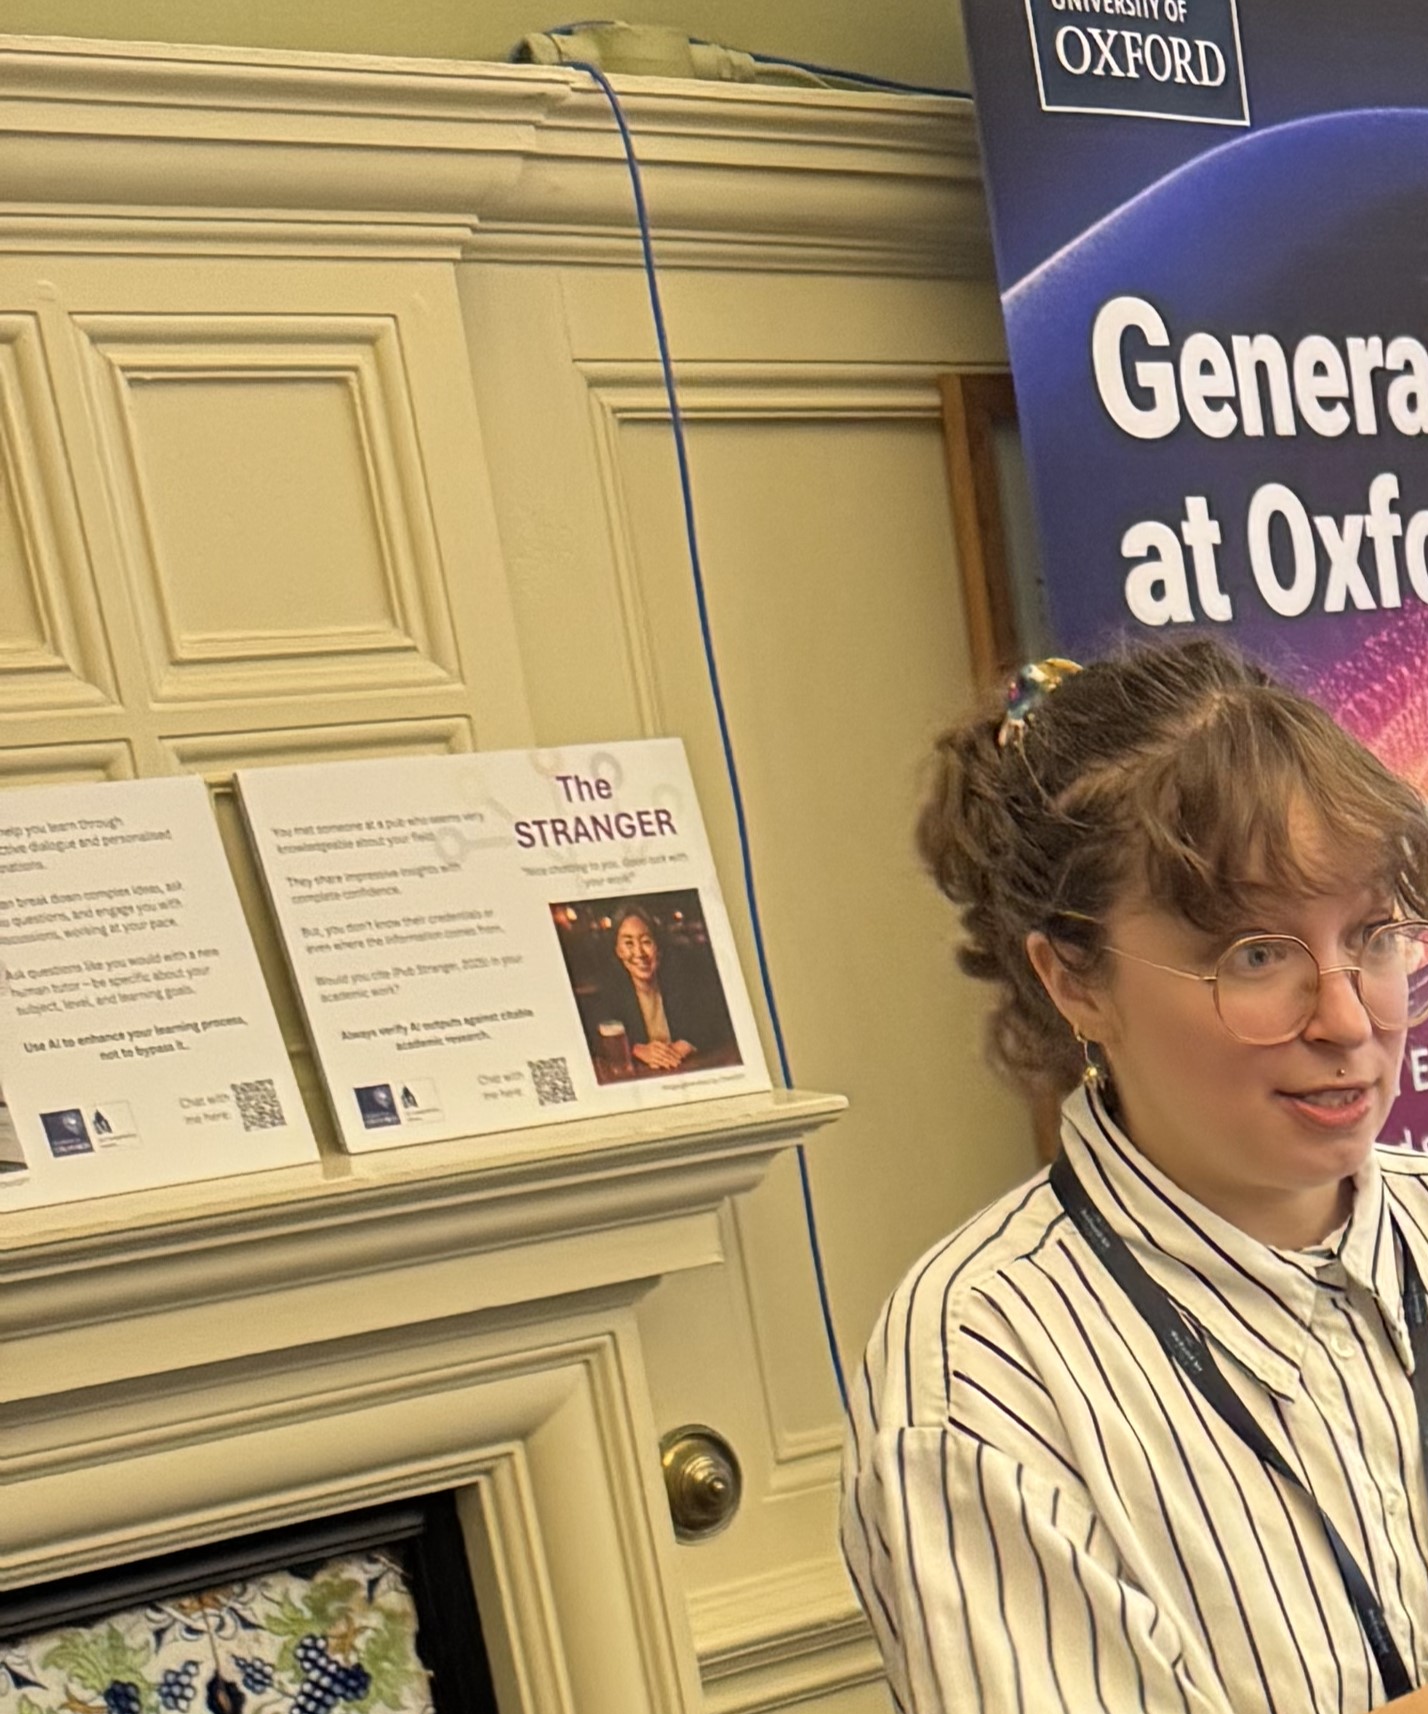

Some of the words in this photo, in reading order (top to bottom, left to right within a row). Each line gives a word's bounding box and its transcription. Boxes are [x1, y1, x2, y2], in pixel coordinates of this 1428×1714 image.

[1164, 0, 1188, 23] OF
[1055, 25, 1226, 87] OXFORD
[1120, 494, 1233, 627] at
[556, 775, 613, 803] The
[515, 809, 677, 849] STRANGER
[24, 1041, 45, 1053] Use
[63, 1037, 75, 1048] to
[78, 1031, 125, 1045] enhance
[127, 1030, 153, 1042] your
[155, 1020, 200, 1035] learning
[99, 1048, 121, 1060] not
[123, 1046, 134, 1058] to
[136, 1044, 172, 1059] bypass
